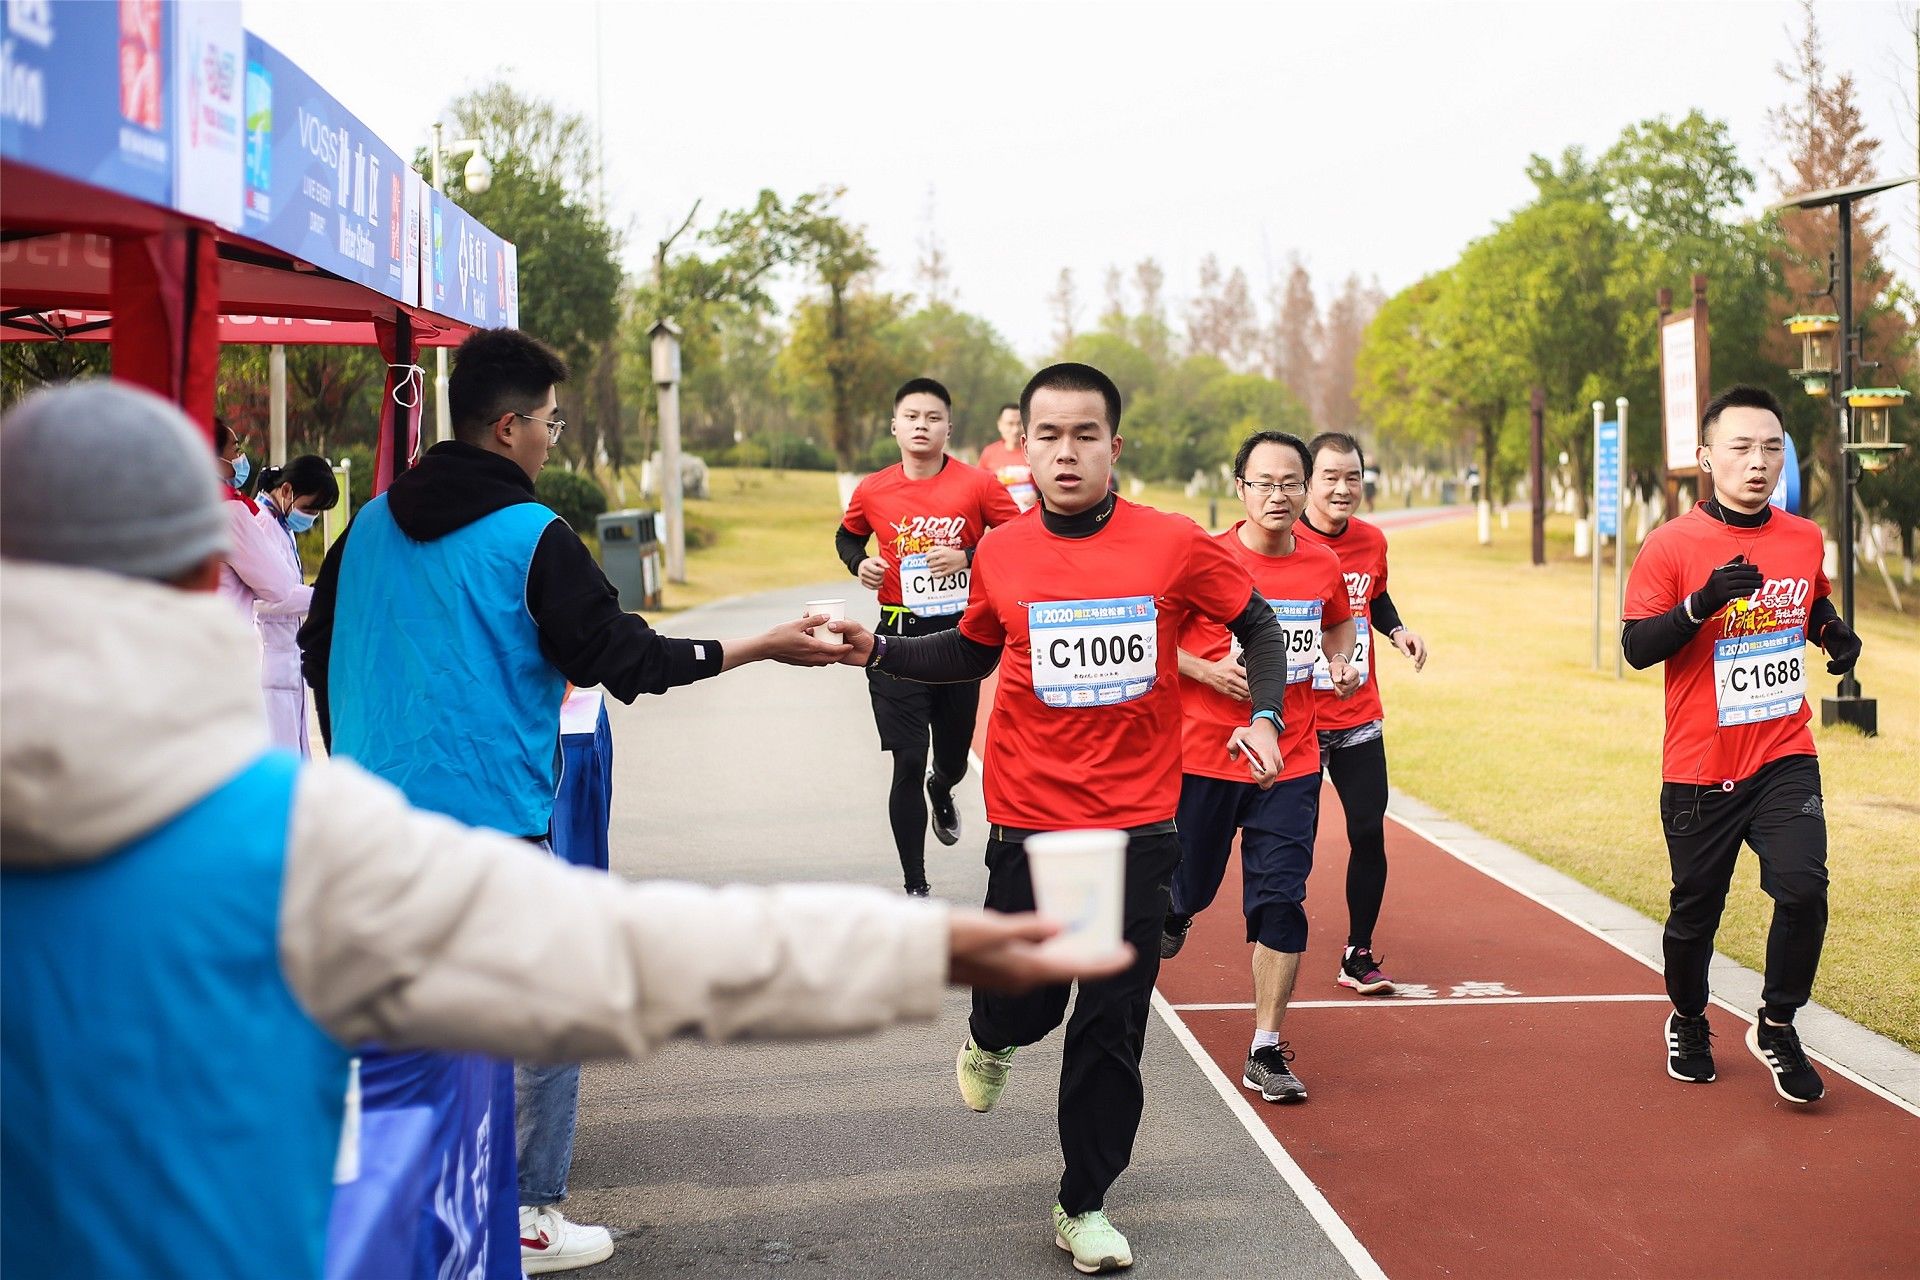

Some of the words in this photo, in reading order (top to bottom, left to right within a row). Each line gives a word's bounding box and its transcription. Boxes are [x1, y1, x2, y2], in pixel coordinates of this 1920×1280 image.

[298, 106, 338, 168] VOSS
[356, 224, 375, 269] Station
[911, 516, 966, 539] 2020
[913, 571, 968, 594] C1230
[1049, 633, 1145, 669] C1006
[1731, 657, 1801, 692] C1688
